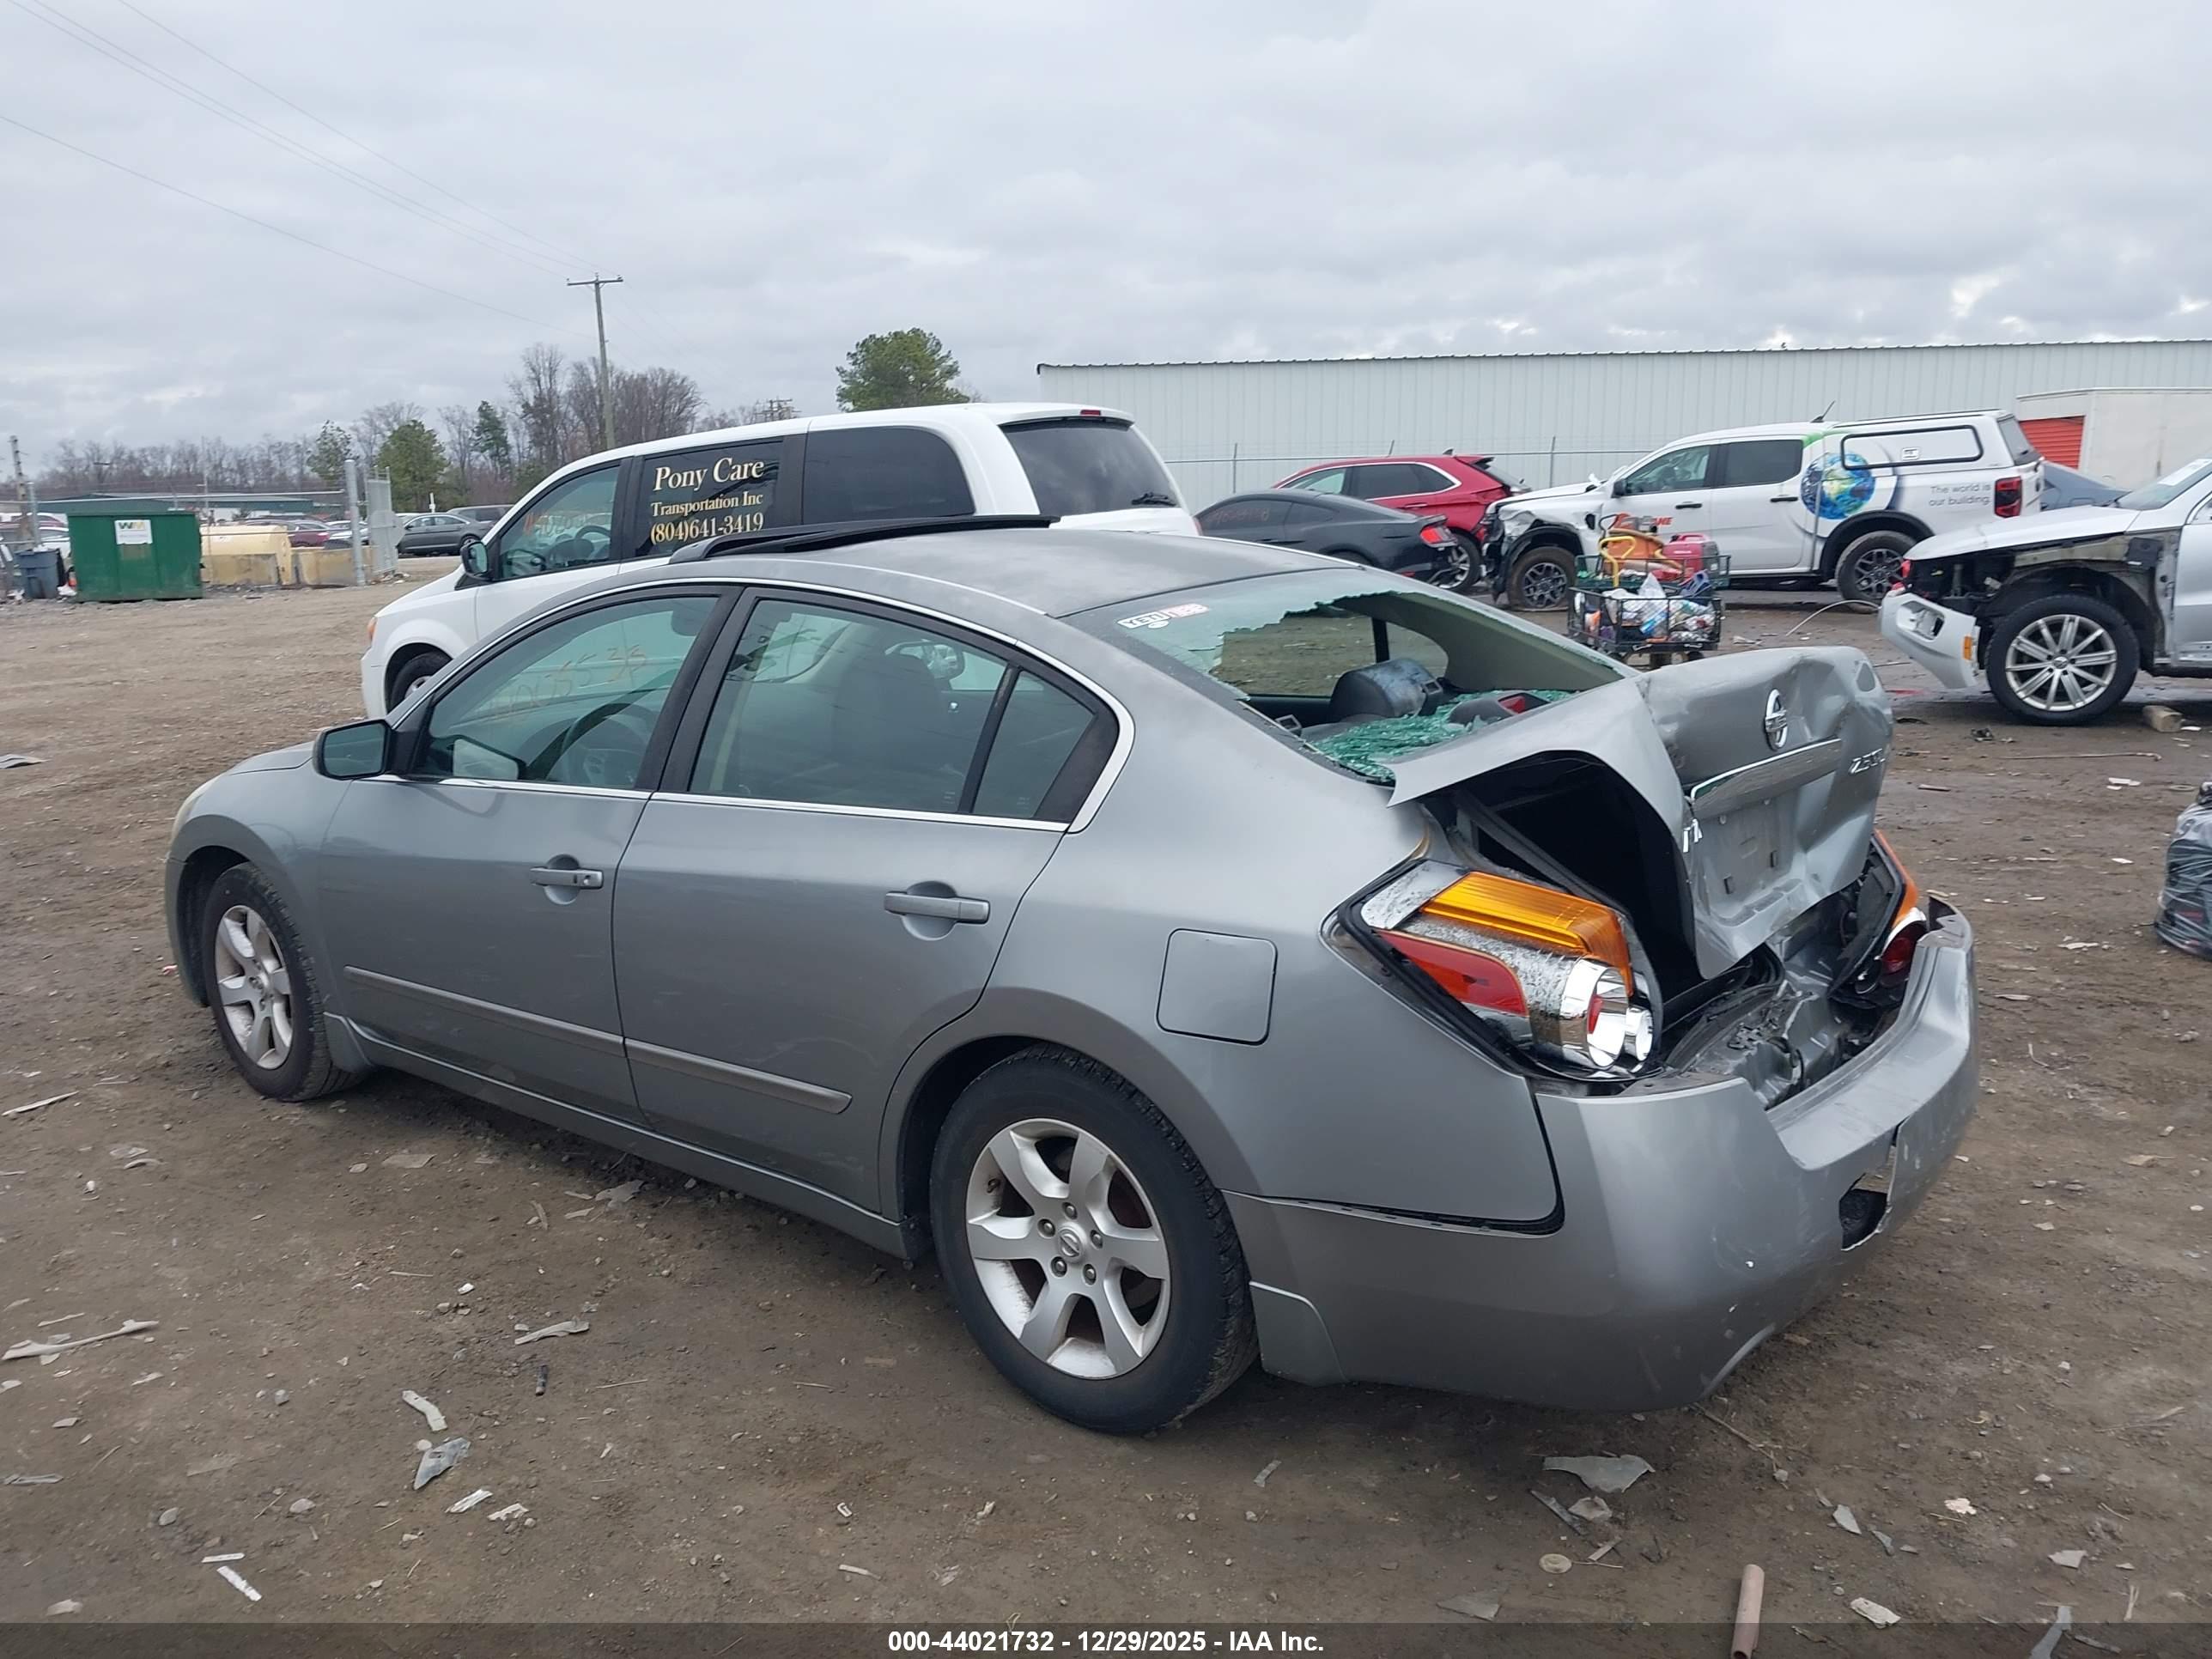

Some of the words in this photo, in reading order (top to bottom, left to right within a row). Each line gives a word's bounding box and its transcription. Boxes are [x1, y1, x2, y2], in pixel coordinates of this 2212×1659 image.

[653, 466, 708, 491] Pony
[713, 457, 764, 483] Care
[651, 495, 738, 516] Transportation
[743, 490, 763, 506] Inc
[1929, 486, 1950, 495] The
[1953, 484, 1980, 494] world
[1983, 483, 1991, 492] is
[651, 512, 764, 545] (804)641-3419
